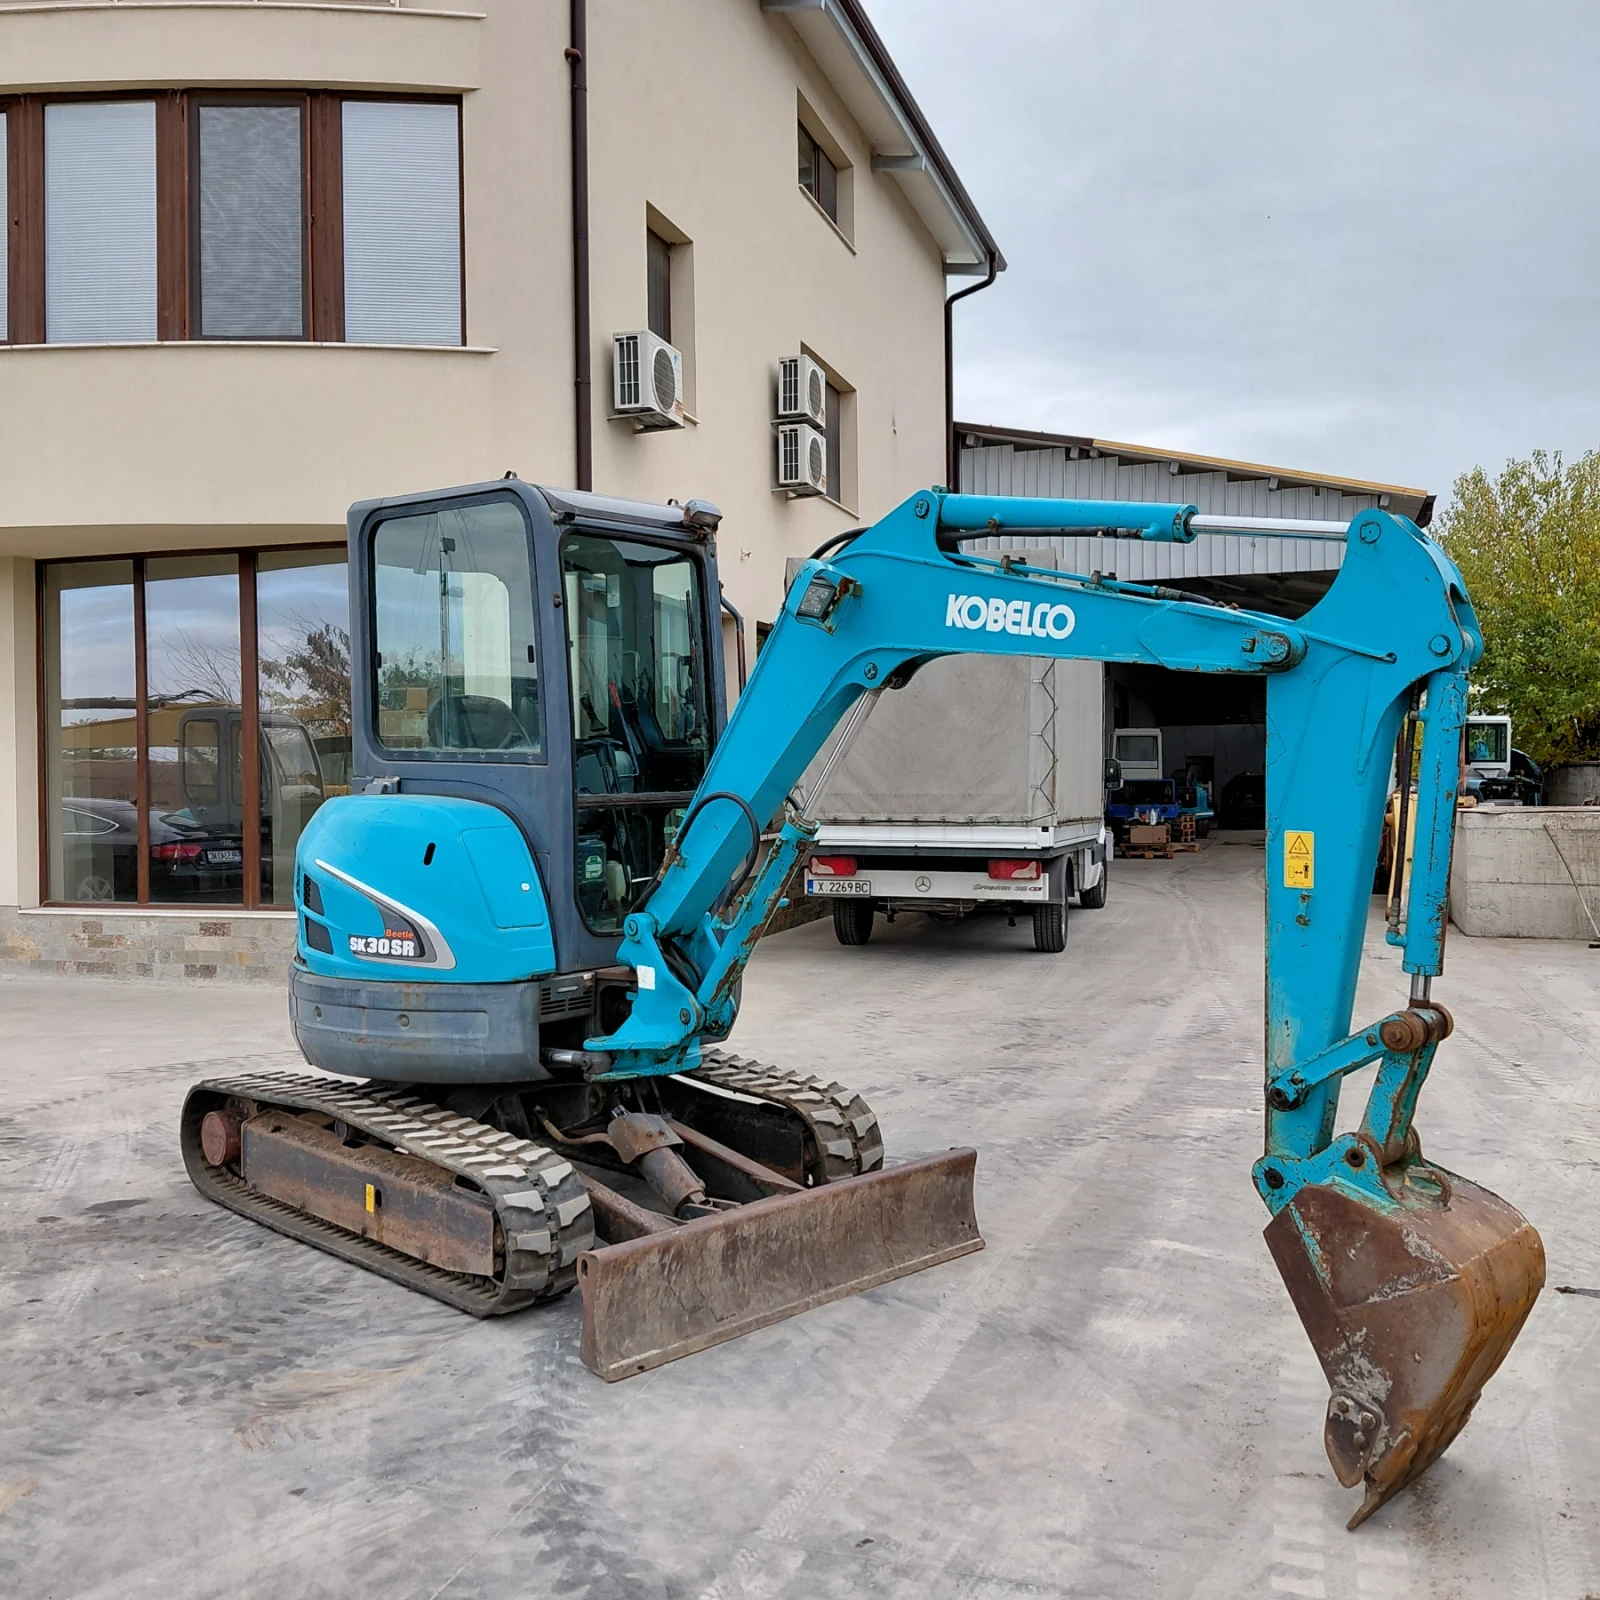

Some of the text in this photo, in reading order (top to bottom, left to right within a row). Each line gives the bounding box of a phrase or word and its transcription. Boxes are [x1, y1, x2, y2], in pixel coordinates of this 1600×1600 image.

[945, 593, 1076, 640] KOBELCO
[385, 929, 414, 939] Beetle
[349, 937, 415, 957] SK30SR
